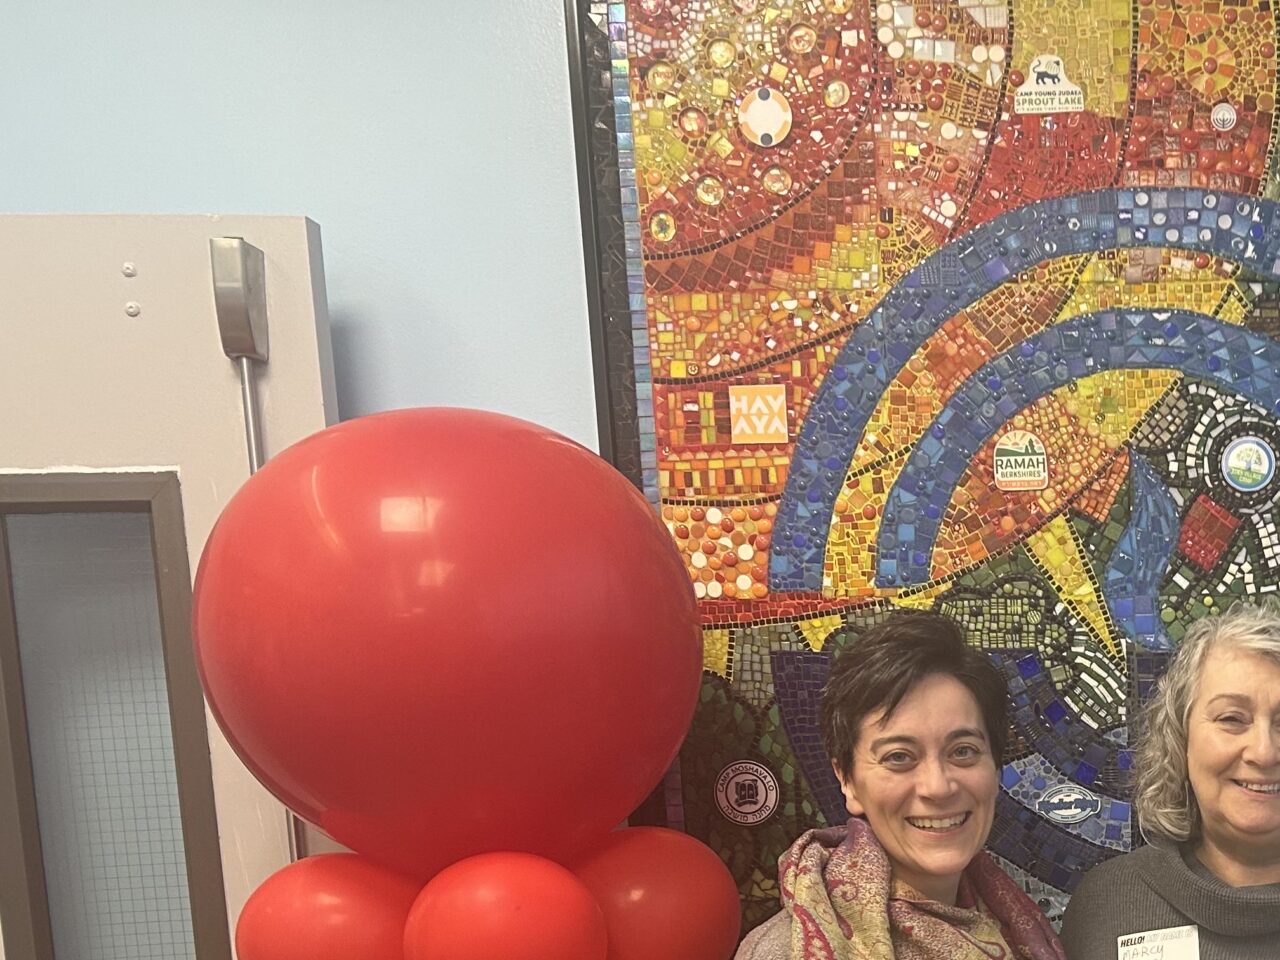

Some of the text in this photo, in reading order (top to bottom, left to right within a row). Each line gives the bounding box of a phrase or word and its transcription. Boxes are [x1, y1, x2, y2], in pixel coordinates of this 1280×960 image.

[1016, 97, 1082, 106] SPROUT LAKE
[730, 395, 785, 415] HAV
[733, 415, 787, 435] AYA
[995, 458, 1046, 474] RAMAH
[1000, 470, 1041, 478] BERKSHIRES
[718, 771, 731, 793] CAMP
[730, 765, 768, 782] MOSHAVA
[1120, 935, 1146, 948] HELLO!
